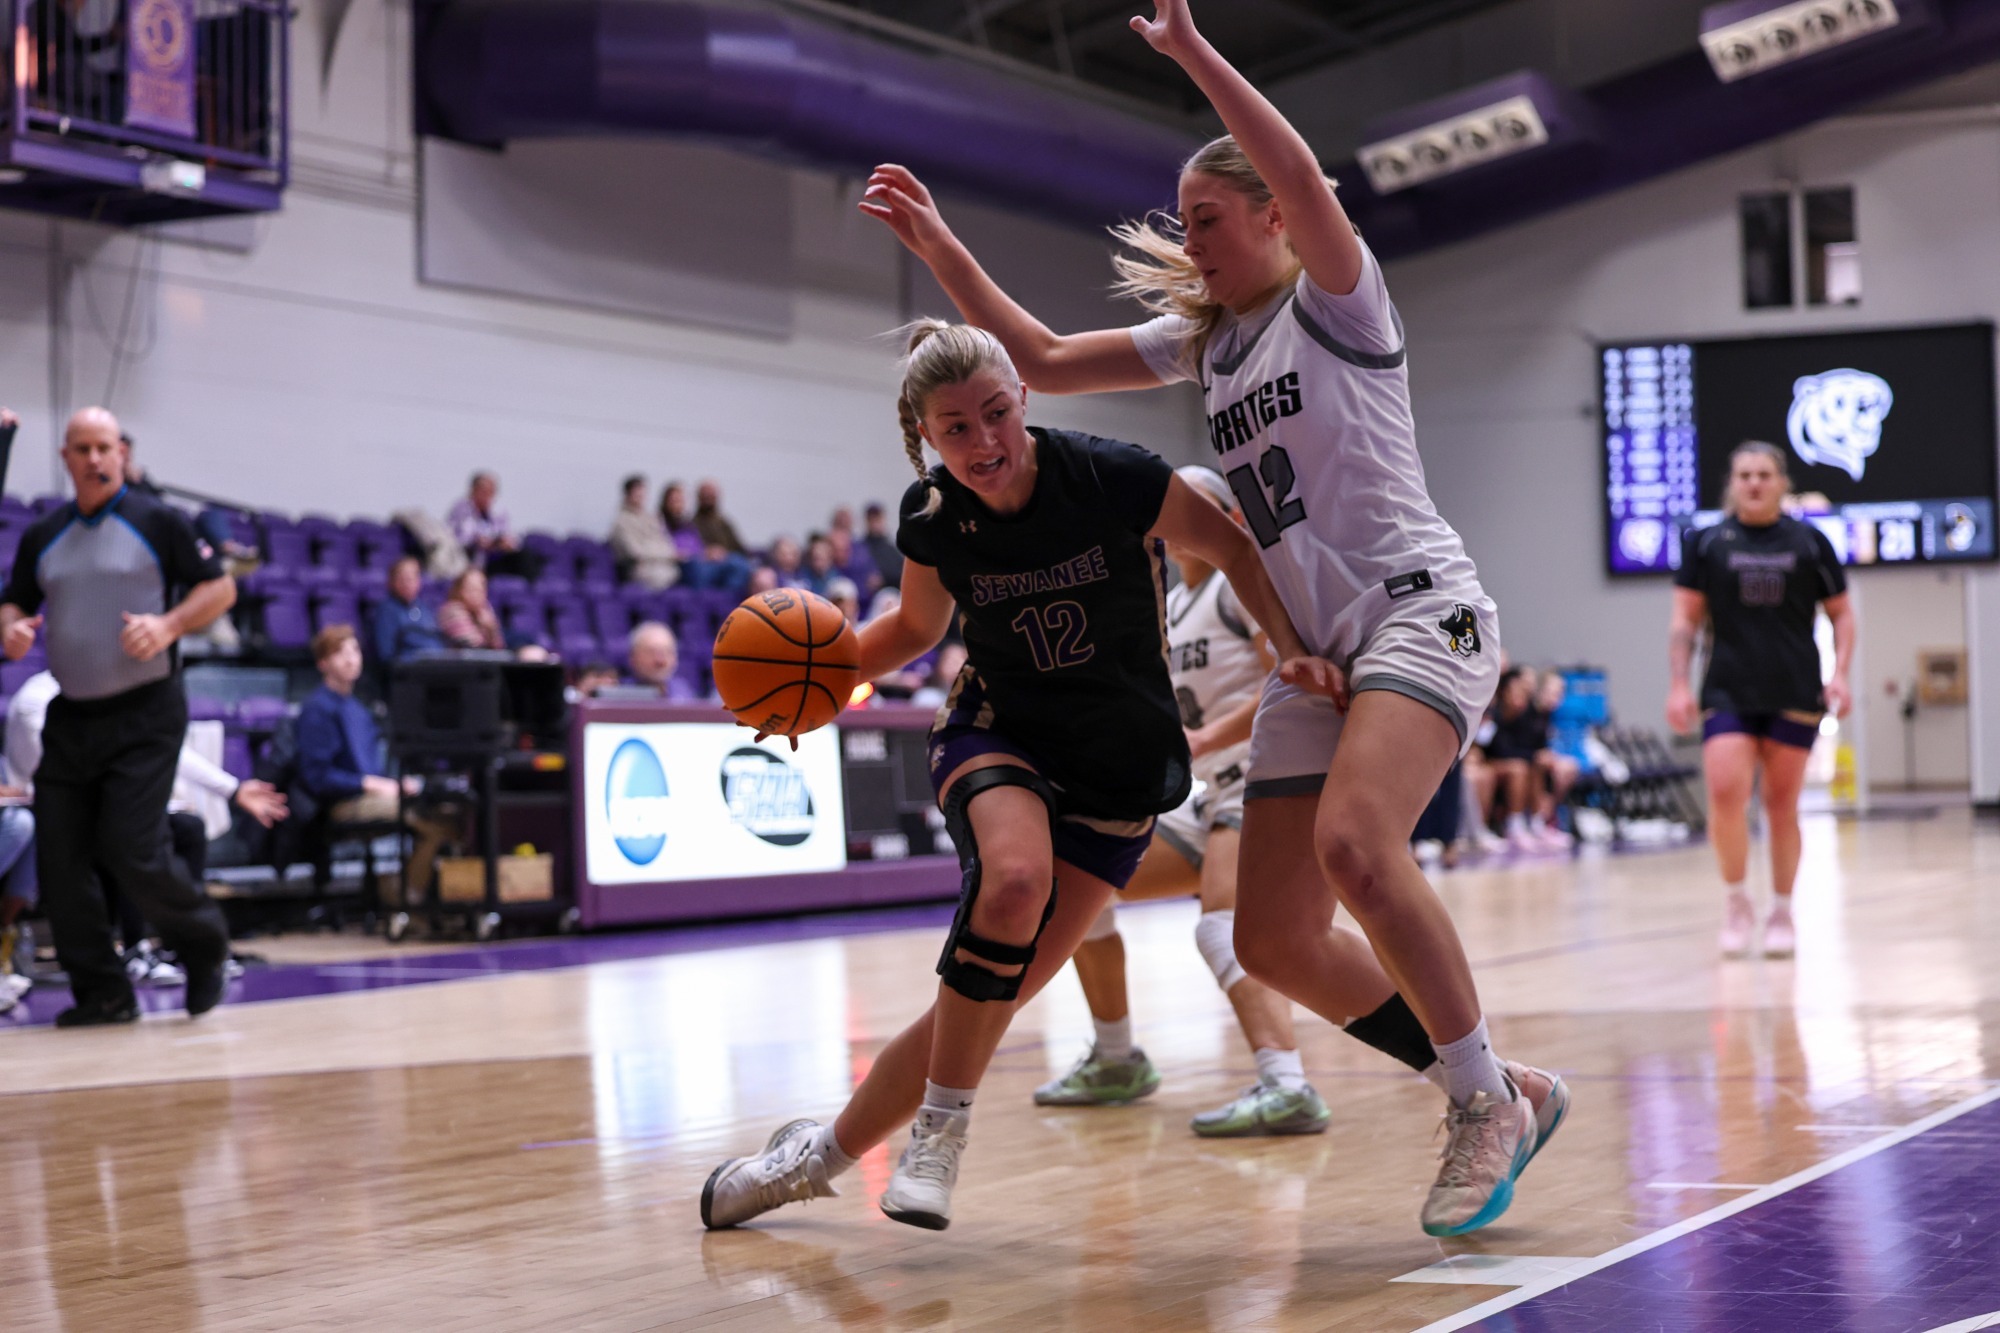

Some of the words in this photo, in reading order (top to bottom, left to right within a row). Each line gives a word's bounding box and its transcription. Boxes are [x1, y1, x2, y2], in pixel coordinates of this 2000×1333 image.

[1226, 444, 1308, 550] 12
[971, 545, 1109, 606] SEWANEE
[1011, 600, 1095, 671] 12
